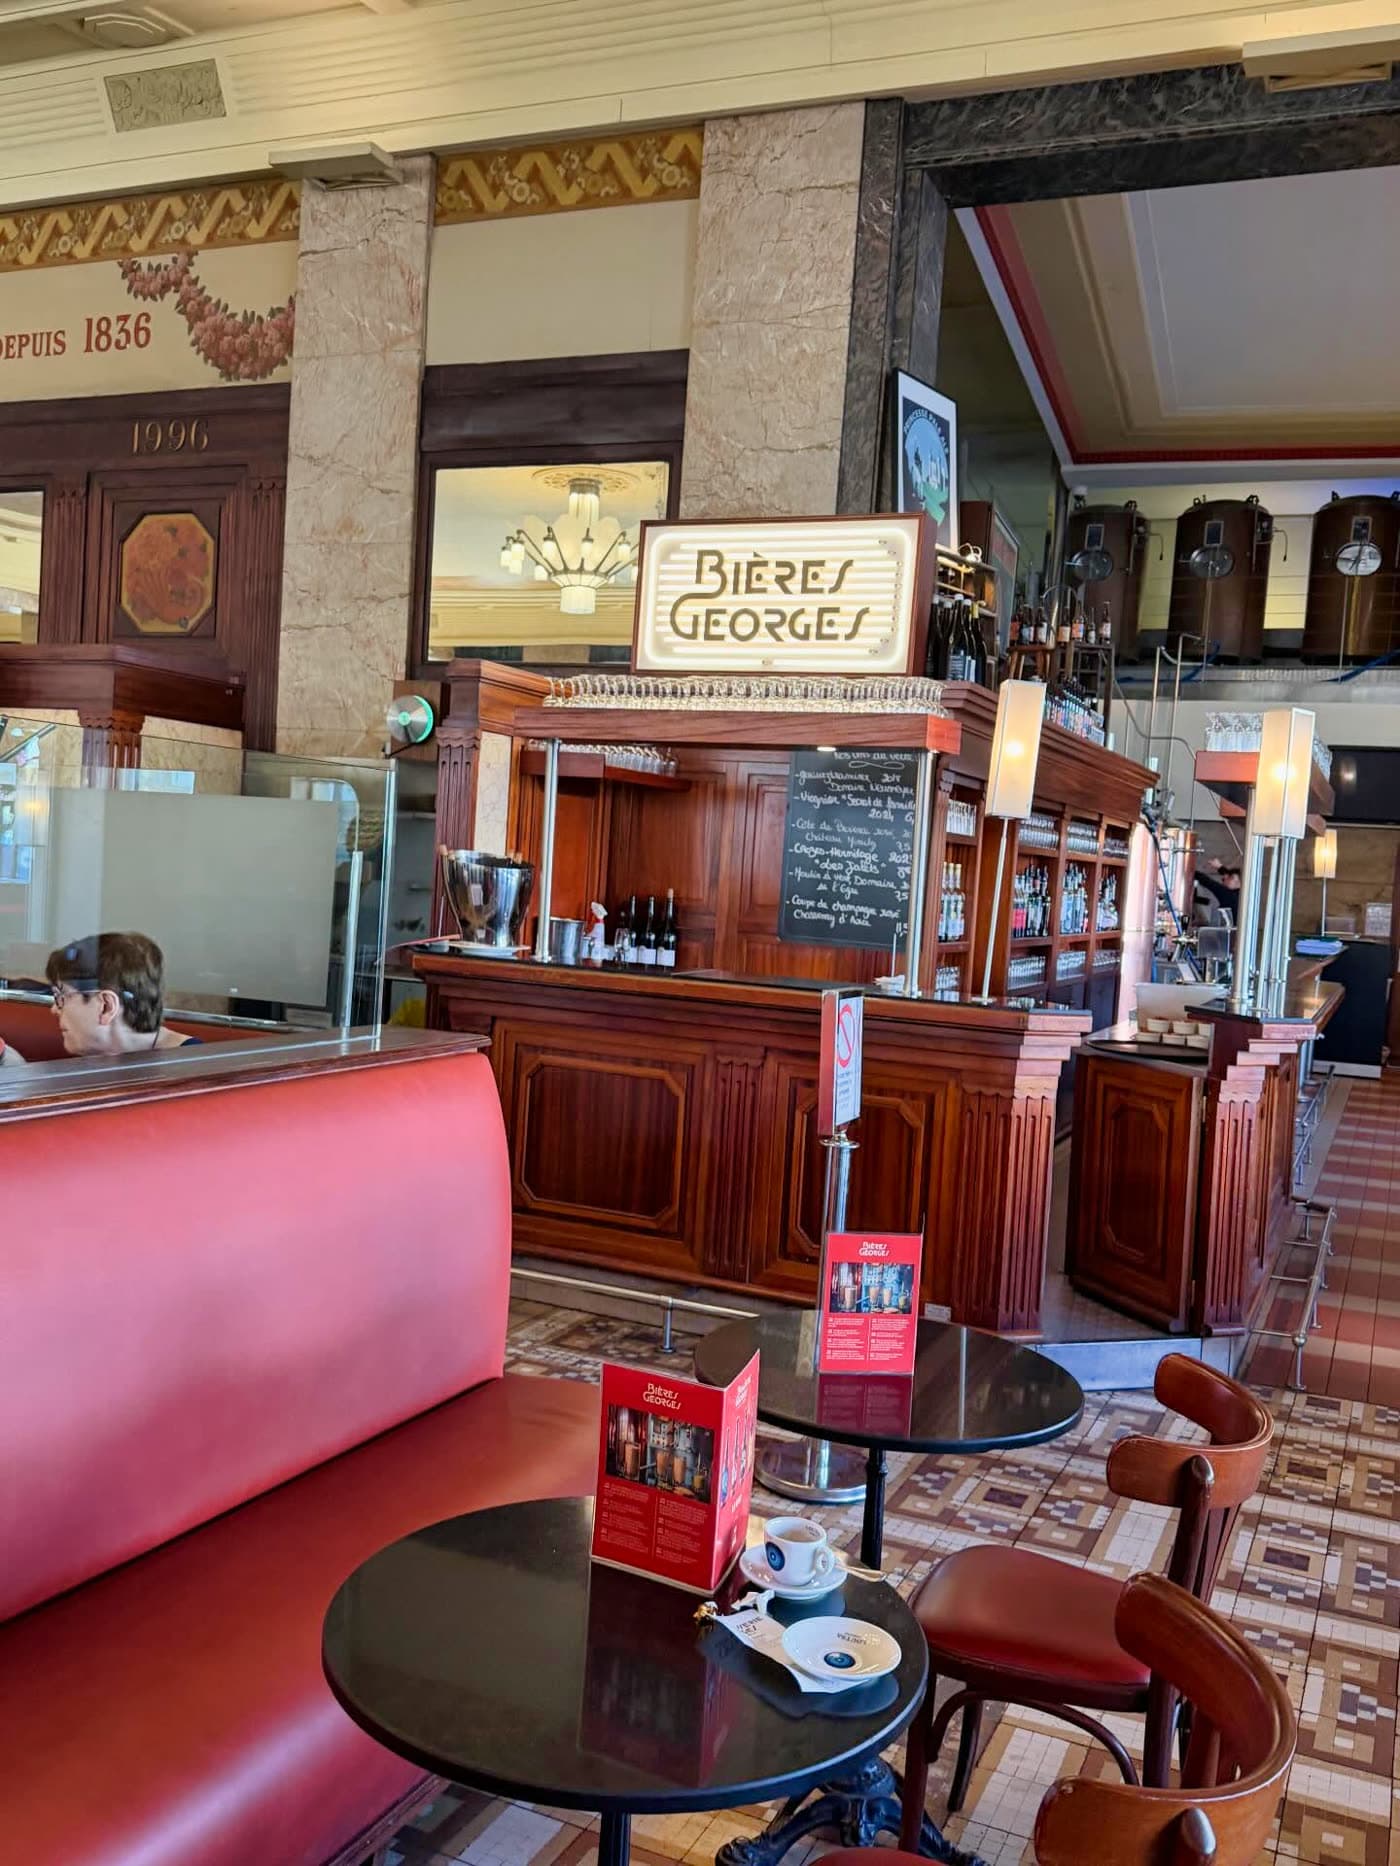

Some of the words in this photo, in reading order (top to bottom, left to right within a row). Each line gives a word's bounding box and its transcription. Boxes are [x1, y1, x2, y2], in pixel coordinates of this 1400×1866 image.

[0, 330, 66, 360] EPUIS
[84, 312, 151, 353] 1836
[132, 419, 209, 453] 1996
[695, 549, 853, 598] BIÈRES
[670, 593, 869, 641] GEORGES
[643, 1391, 682, 1410] GEORGES
